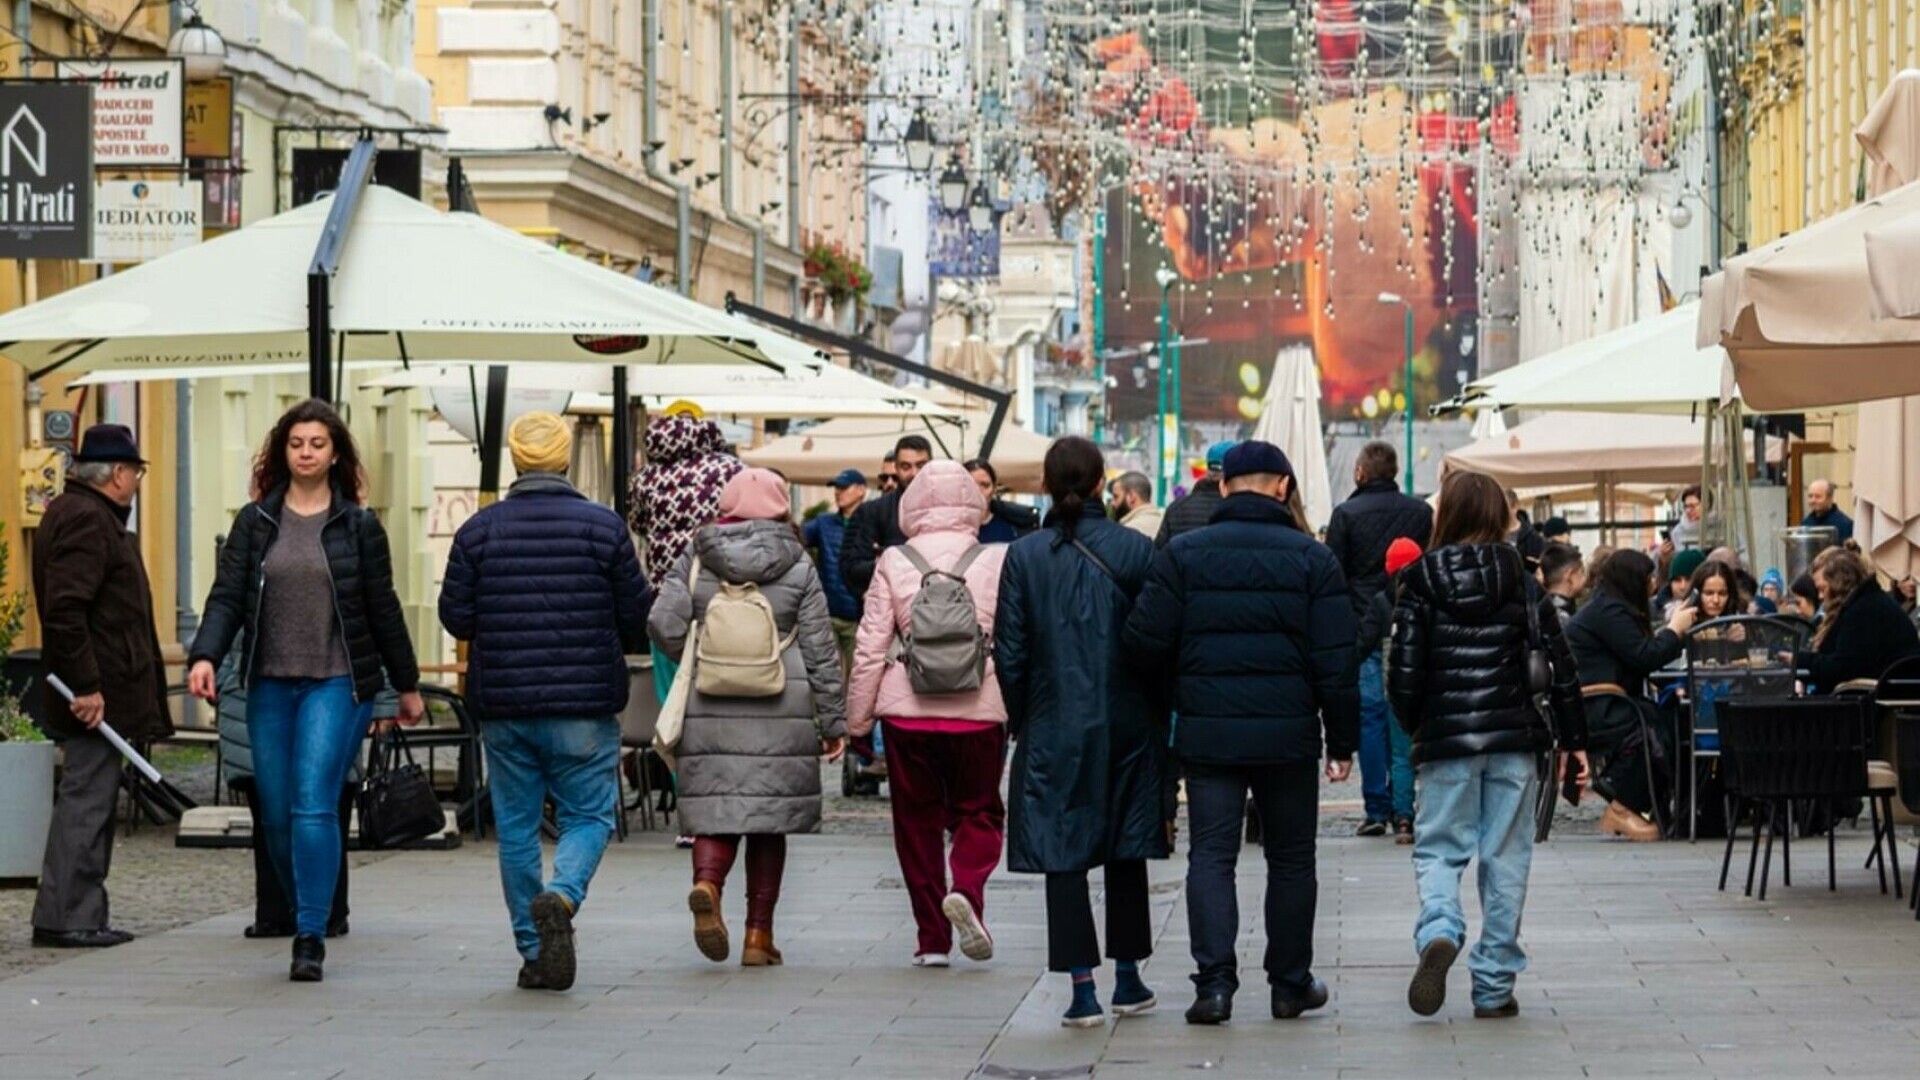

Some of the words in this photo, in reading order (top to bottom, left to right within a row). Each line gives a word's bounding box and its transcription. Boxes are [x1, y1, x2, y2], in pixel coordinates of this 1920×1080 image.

[185, 104, 207, 124] AT
[92, 144, 130, 156] NSFER
[0, 182, 9, 222] i
[16, 182, 75, 222] Frati
